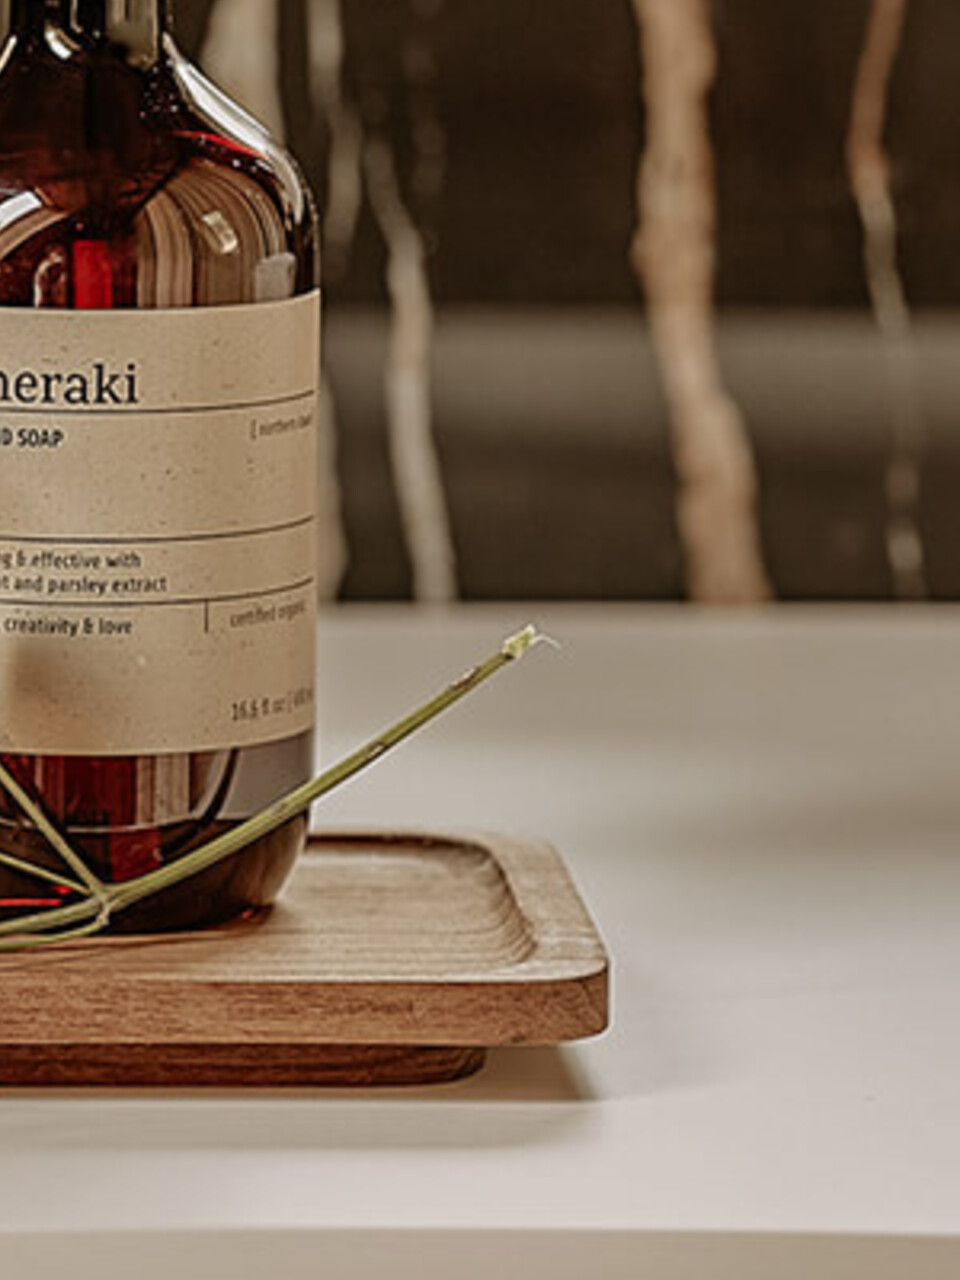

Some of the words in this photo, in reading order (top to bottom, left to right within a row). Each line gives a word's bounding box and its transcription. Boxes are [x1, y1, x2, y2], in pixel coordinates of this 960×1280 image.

[17, 428, 65, 447] SOAP
[31, 551, 100, 569] effective
[105, 552, 141, 568] with
[14, 575, 42, 592] and
[48, 577, 108, 596] parsley
[112, 577, 167, 593] extract
[4, 617, 78, 638] creativity
[83, 617, 93, 634] &
[98, 617, 132, 634] love
